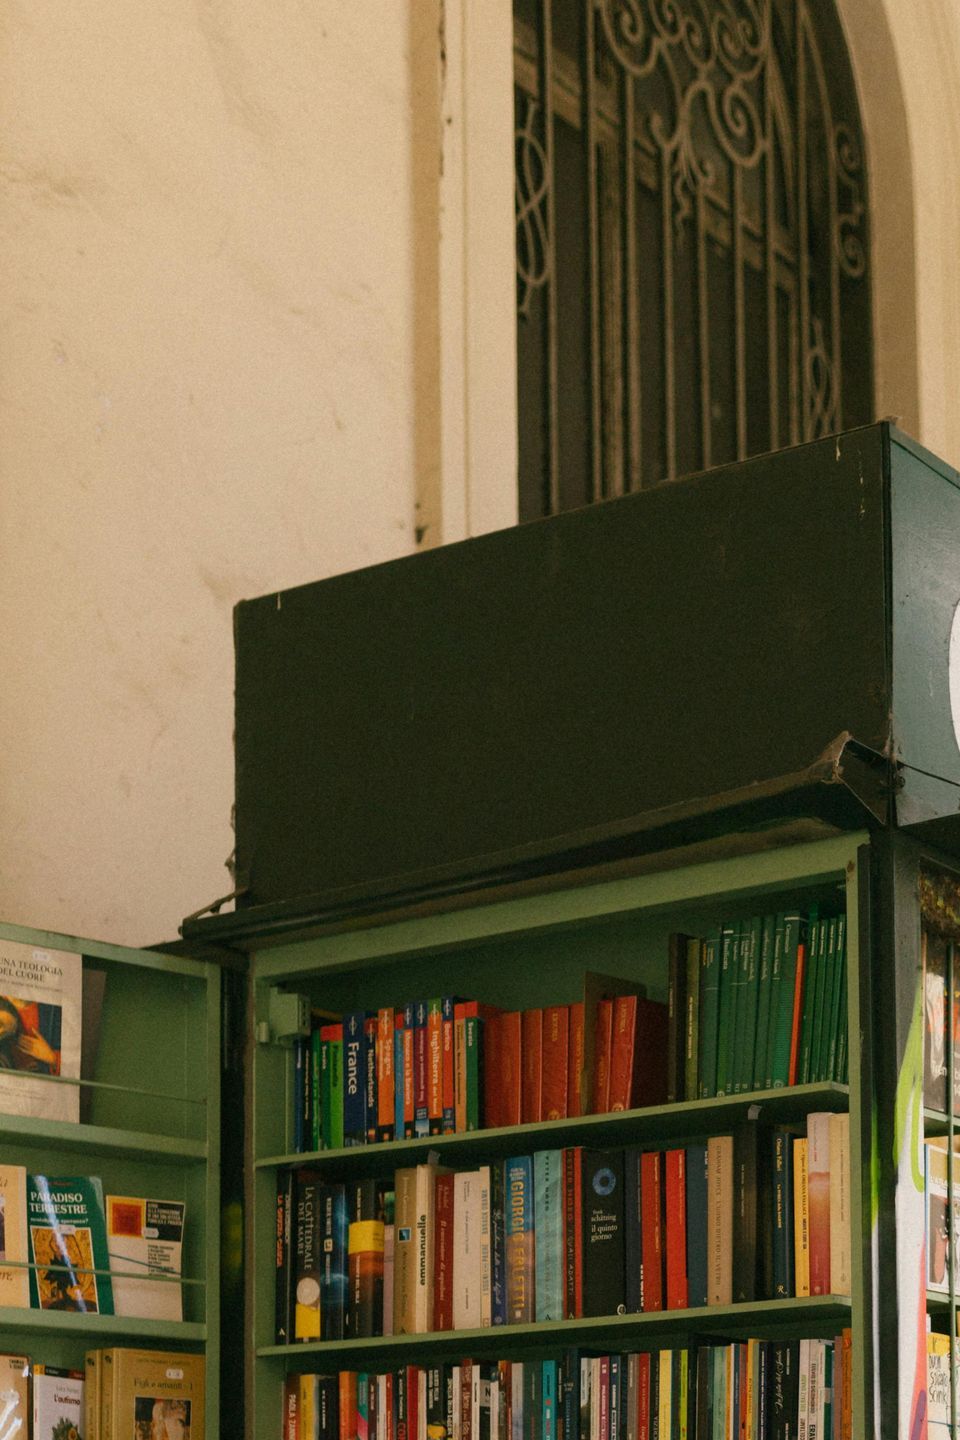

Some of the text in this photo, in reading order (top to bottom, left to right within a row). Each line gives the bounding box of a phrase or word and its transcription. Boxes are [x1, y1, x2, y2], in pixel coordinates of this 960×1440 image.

[15, 971, 45, 983] CUORE
[19, 959, 64, 977] TEOLOGIA
[347, 1041, 360, 1095] France
[383, 1038, 392, 1077] Spagna
[430, 1030, 439, 1084] Inghilterra
[776, 1137, 784, 1156] Oriana
[511, 1181, 525, 1242] GIORGIO
[297, 1202, 305, 1257] DEL MARE
[303, 1187, 315, 1271] LA CATTEDRALE
[591, 1223, 618, 1234] il quinto
[591, 1232, 612, 1243] giorno
[417, 1214, 427, 1286] emmanuelle
[134, 1378, 149, 1391] Figli
[157, 1382, 183, 1390] amanti
[288, 1394, 296, 1417] PAOLA
